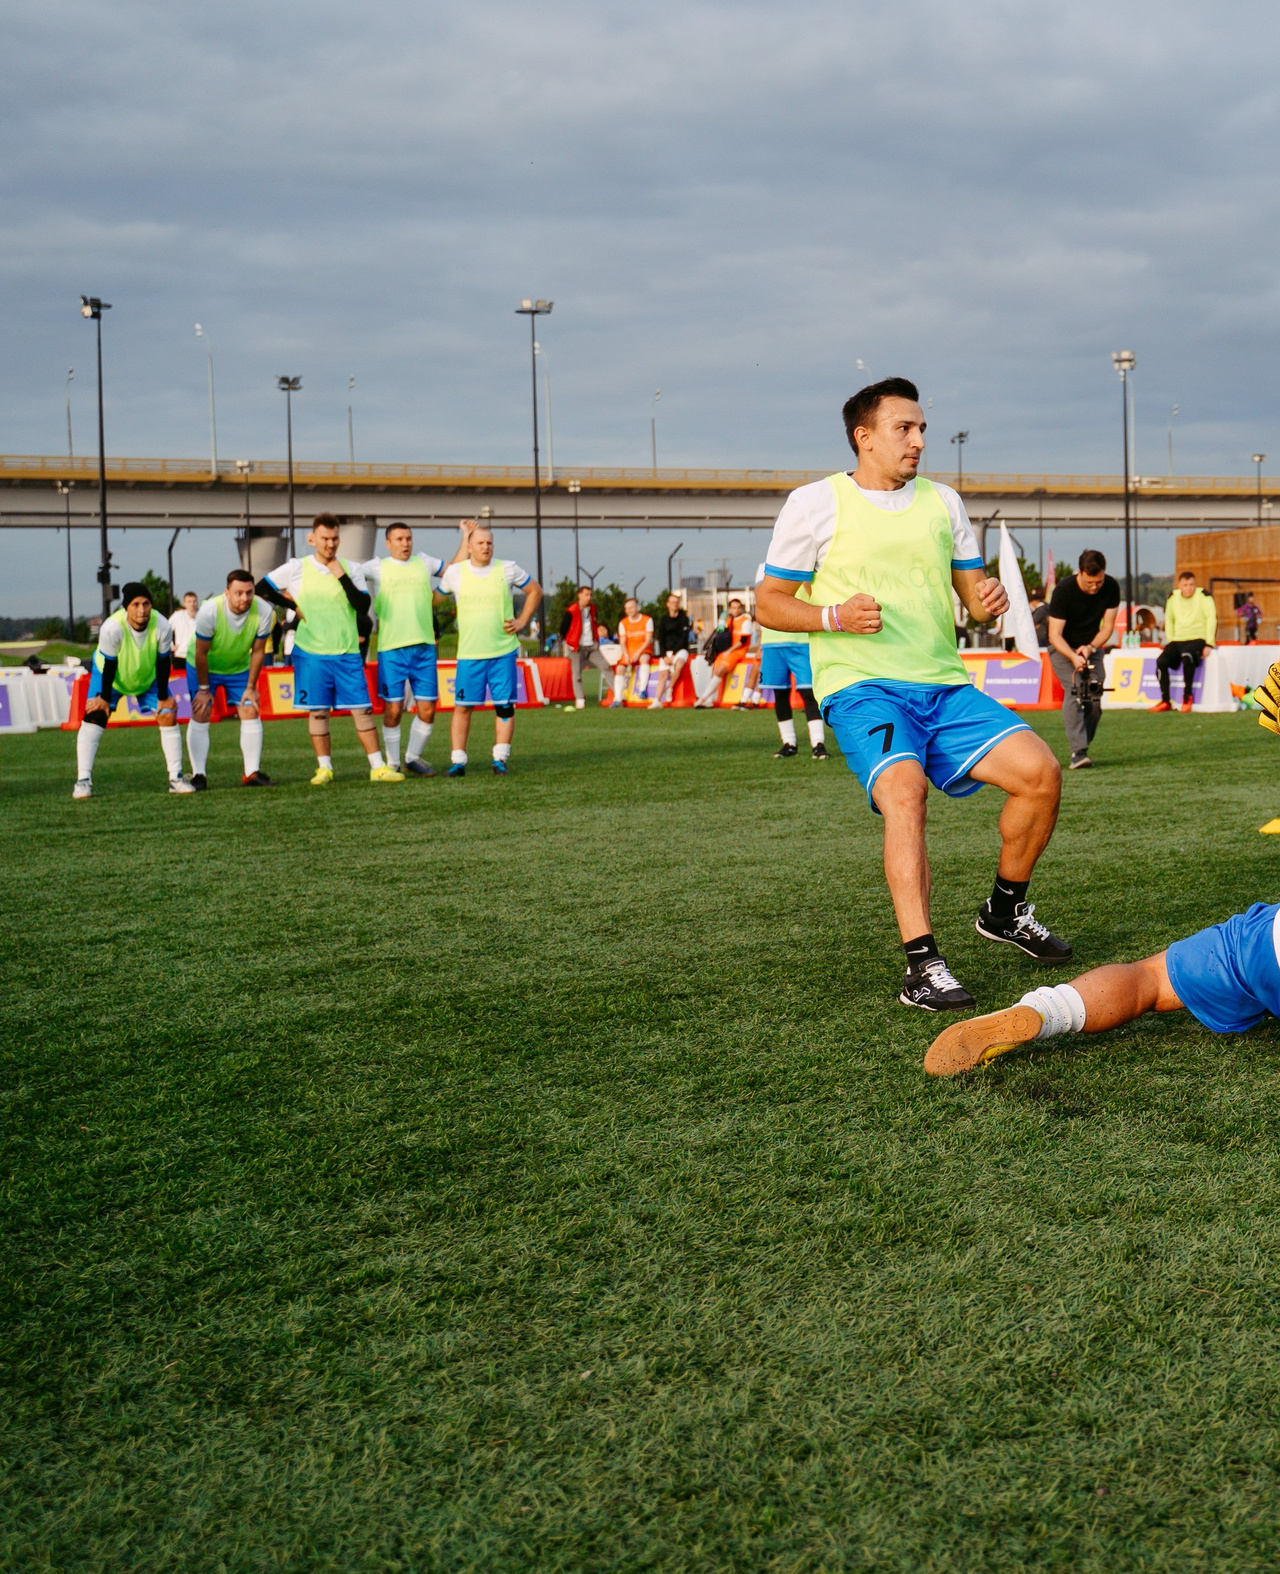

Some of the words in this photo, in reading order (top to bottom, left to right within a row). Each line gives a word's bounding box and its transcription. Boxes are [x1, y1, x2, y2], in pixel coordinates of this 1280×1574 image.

[1119, 669, 1133, 688] 3
[279, 683, 292, 700] 3
[299, 690, 308, 704] 2
[456, 688, 465, 701] 4
[866, 722, 895, 754] 7
